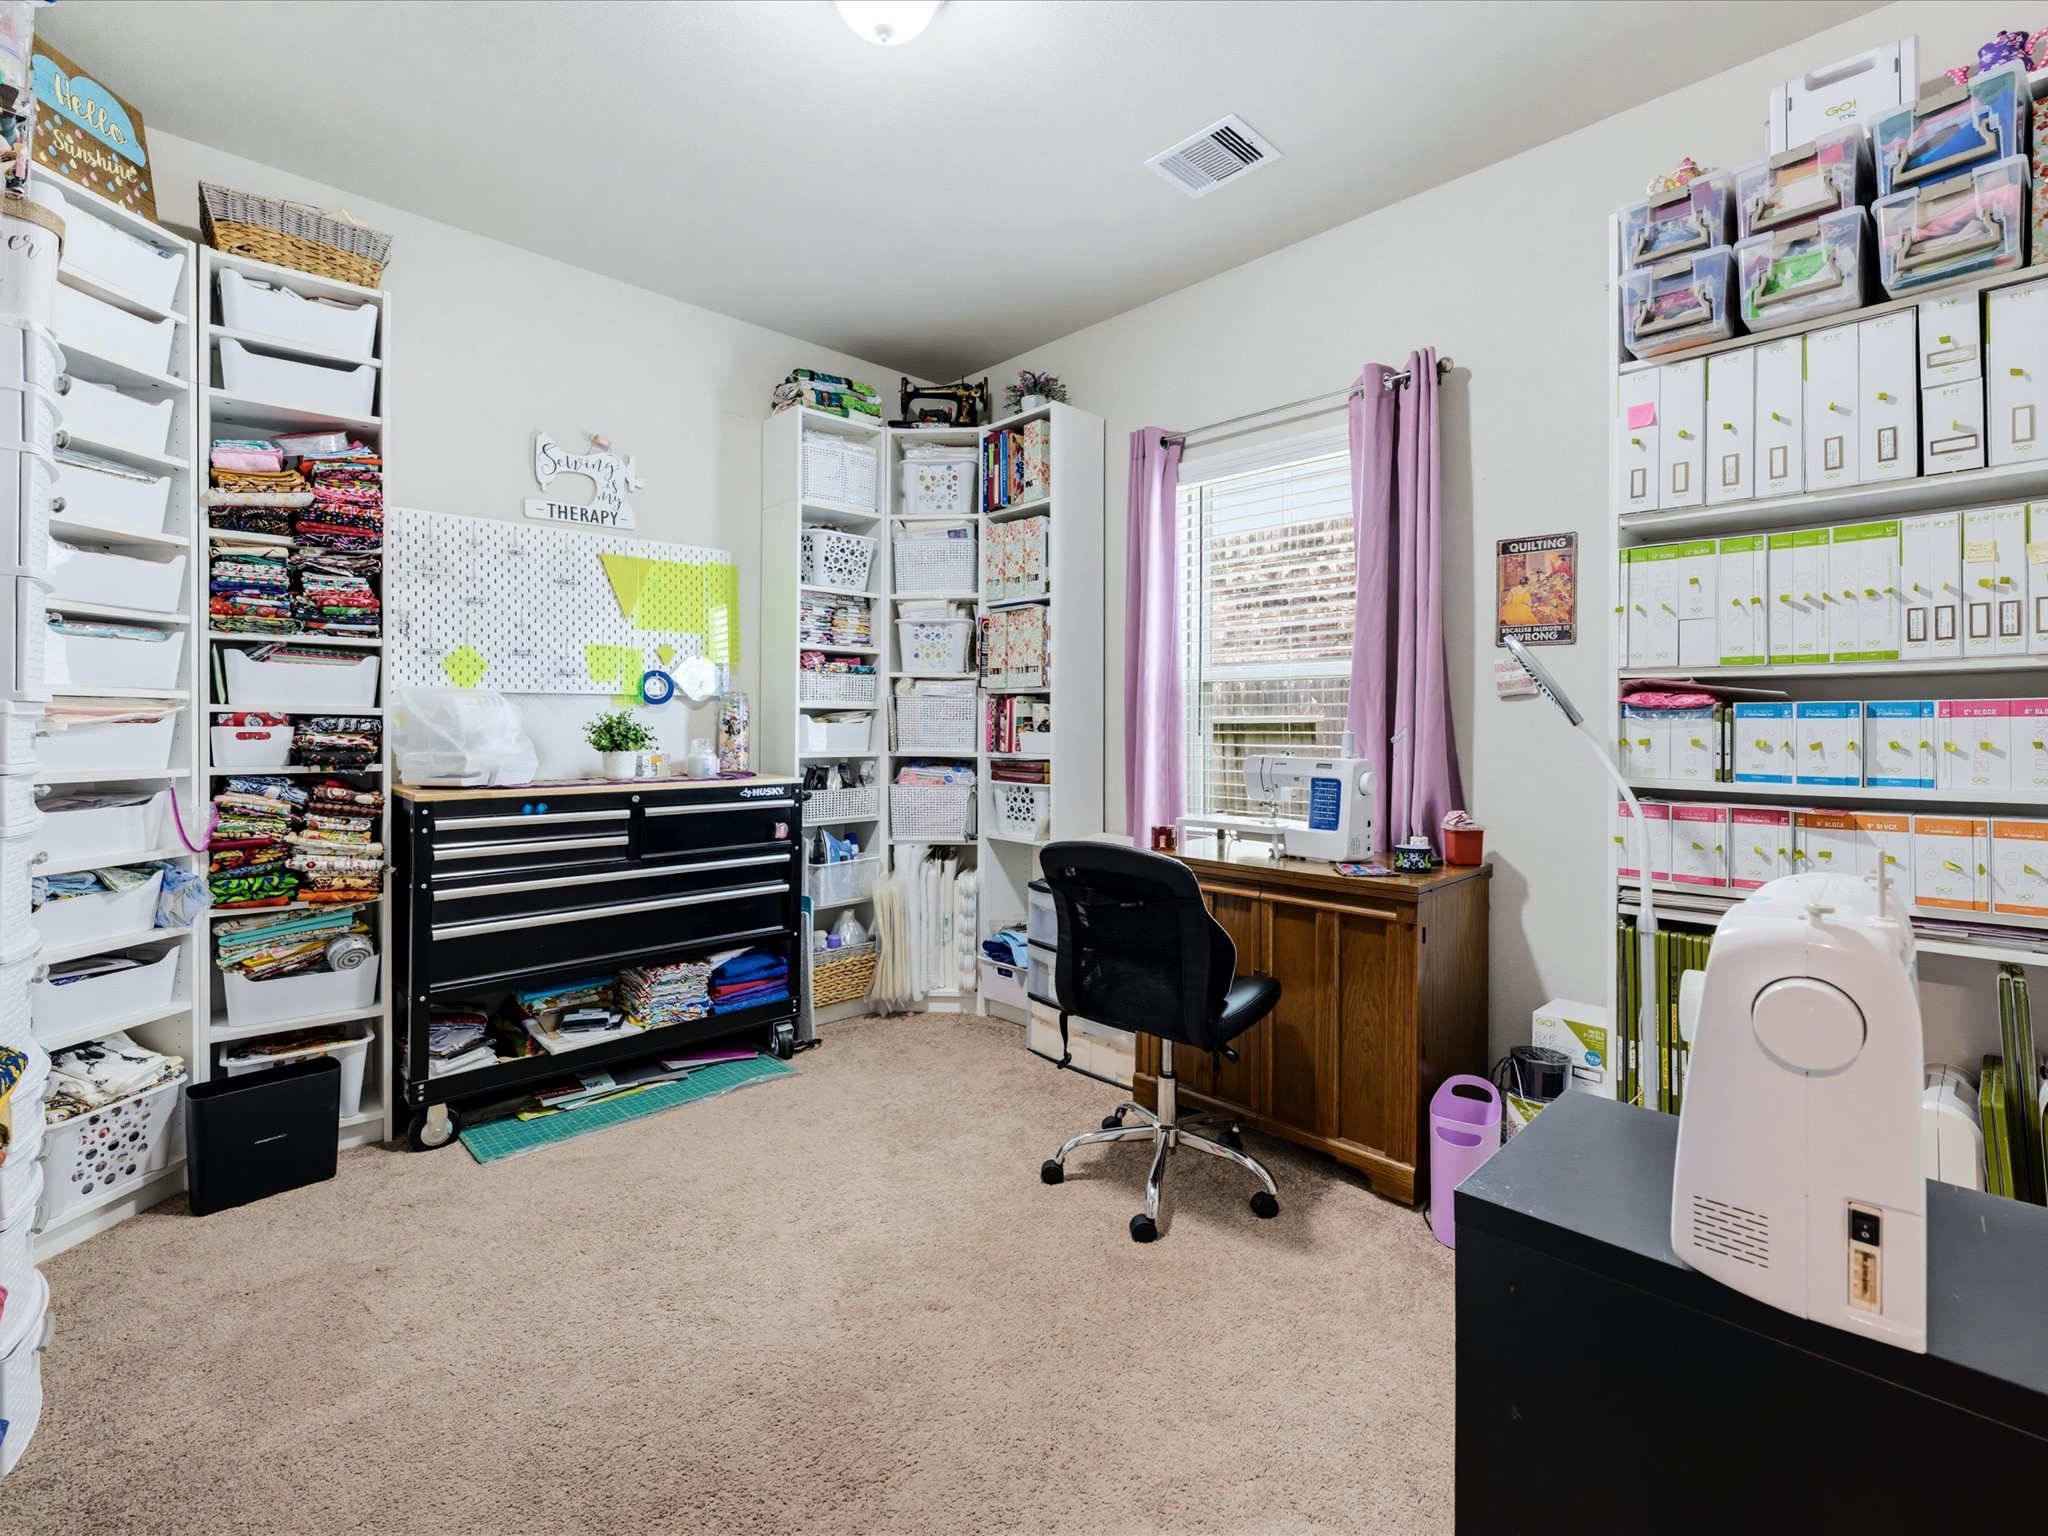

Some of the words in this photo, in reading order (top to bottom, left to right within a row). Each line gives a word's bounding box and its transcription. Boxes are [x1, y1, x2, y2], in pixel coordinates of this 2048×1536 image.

[54, 73, 127, 145] Hello
[1825, 99, 1857, 117] GO!
[53, 129, 137, 183] Sunshine
[538, 443, 620, 481] Sewing
[601, 480, 621, 493] is
[597, 491, 625, 512] my
[546, 502, 618, 525] THERAPY
[1509, 537, 1567, 553] QUILTING
[1512, 631, 1558, 641] WRONG
[752, 786, 785, 797] HUSKY
[1876, 823, 1898, 831] BLOCK
[1536, 1017, 1556, 1029] GO!
